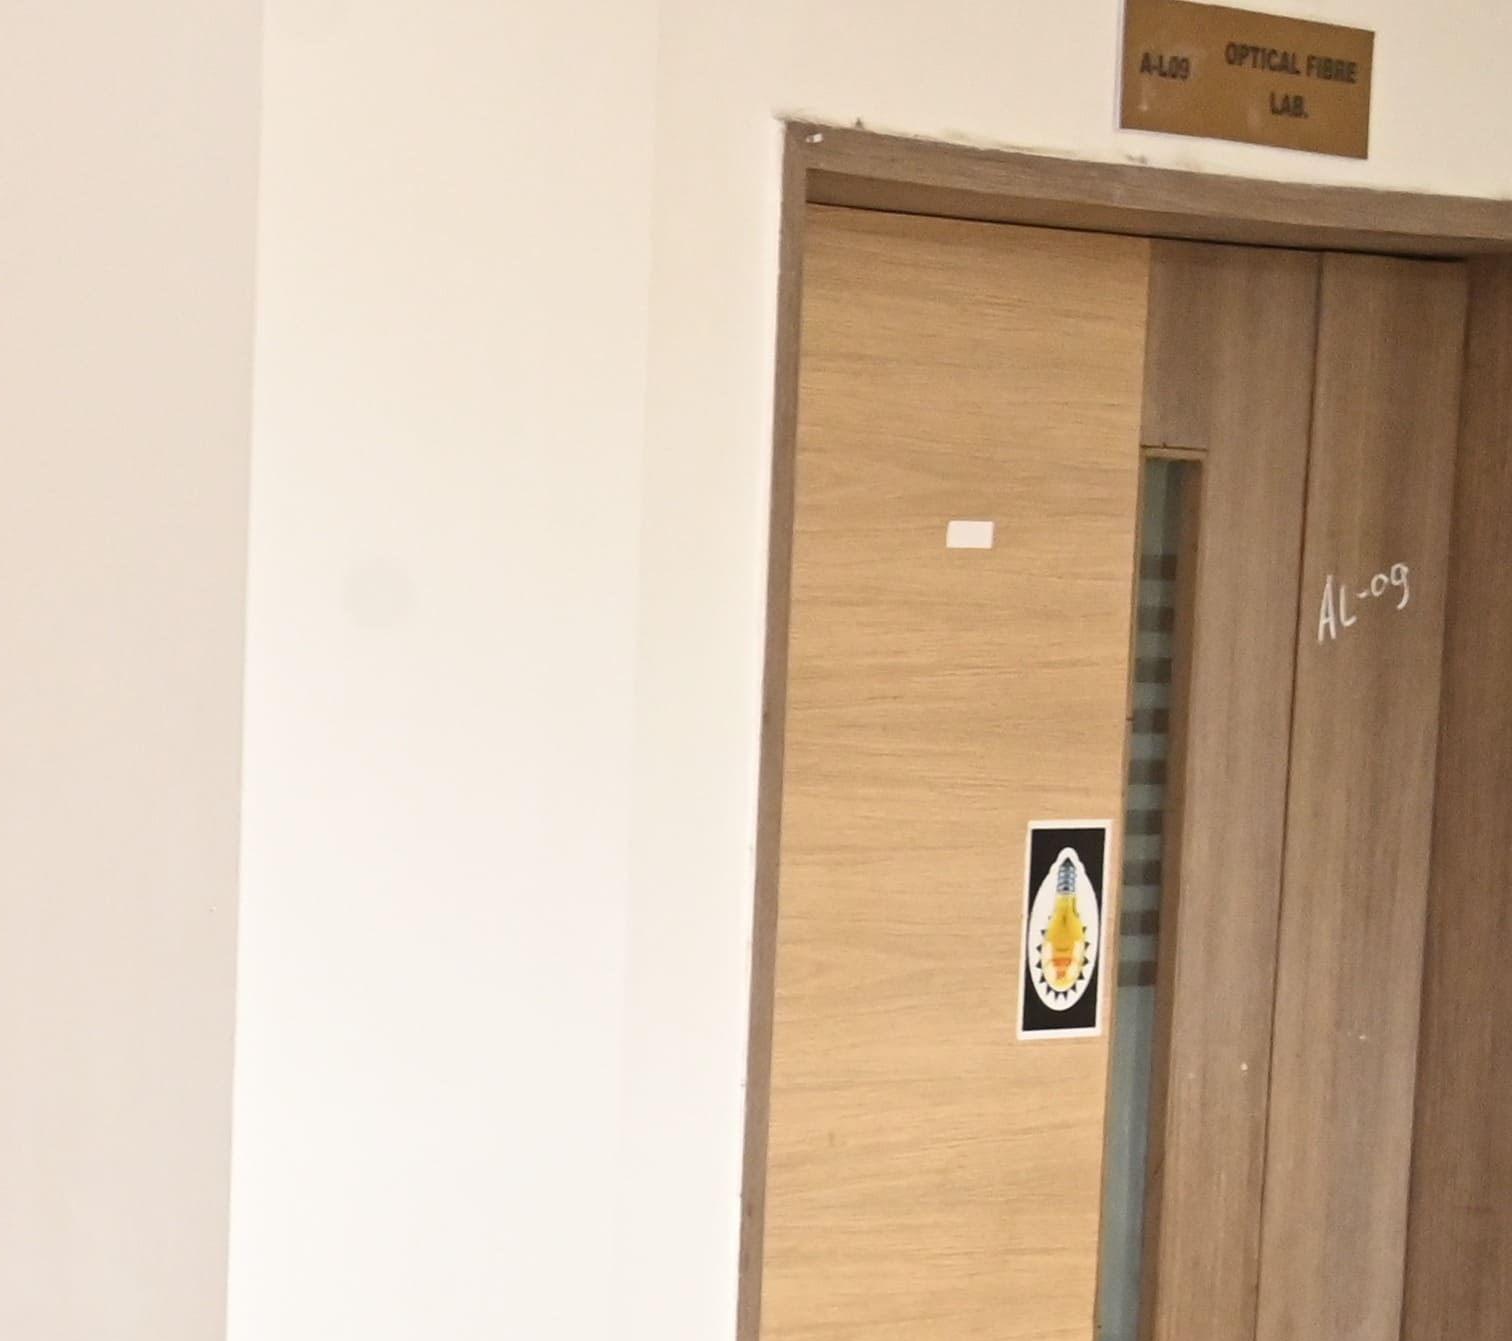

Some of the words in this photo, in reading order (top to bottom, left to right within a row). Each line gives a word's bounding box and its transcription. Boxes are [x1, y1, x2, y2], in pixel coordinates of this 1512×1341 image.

[1224, 42, 1301, 75] OPTICAL
[1306, 54, 1359, 84] FIBRE
[1270, 92, 1309, 119] LAB.
